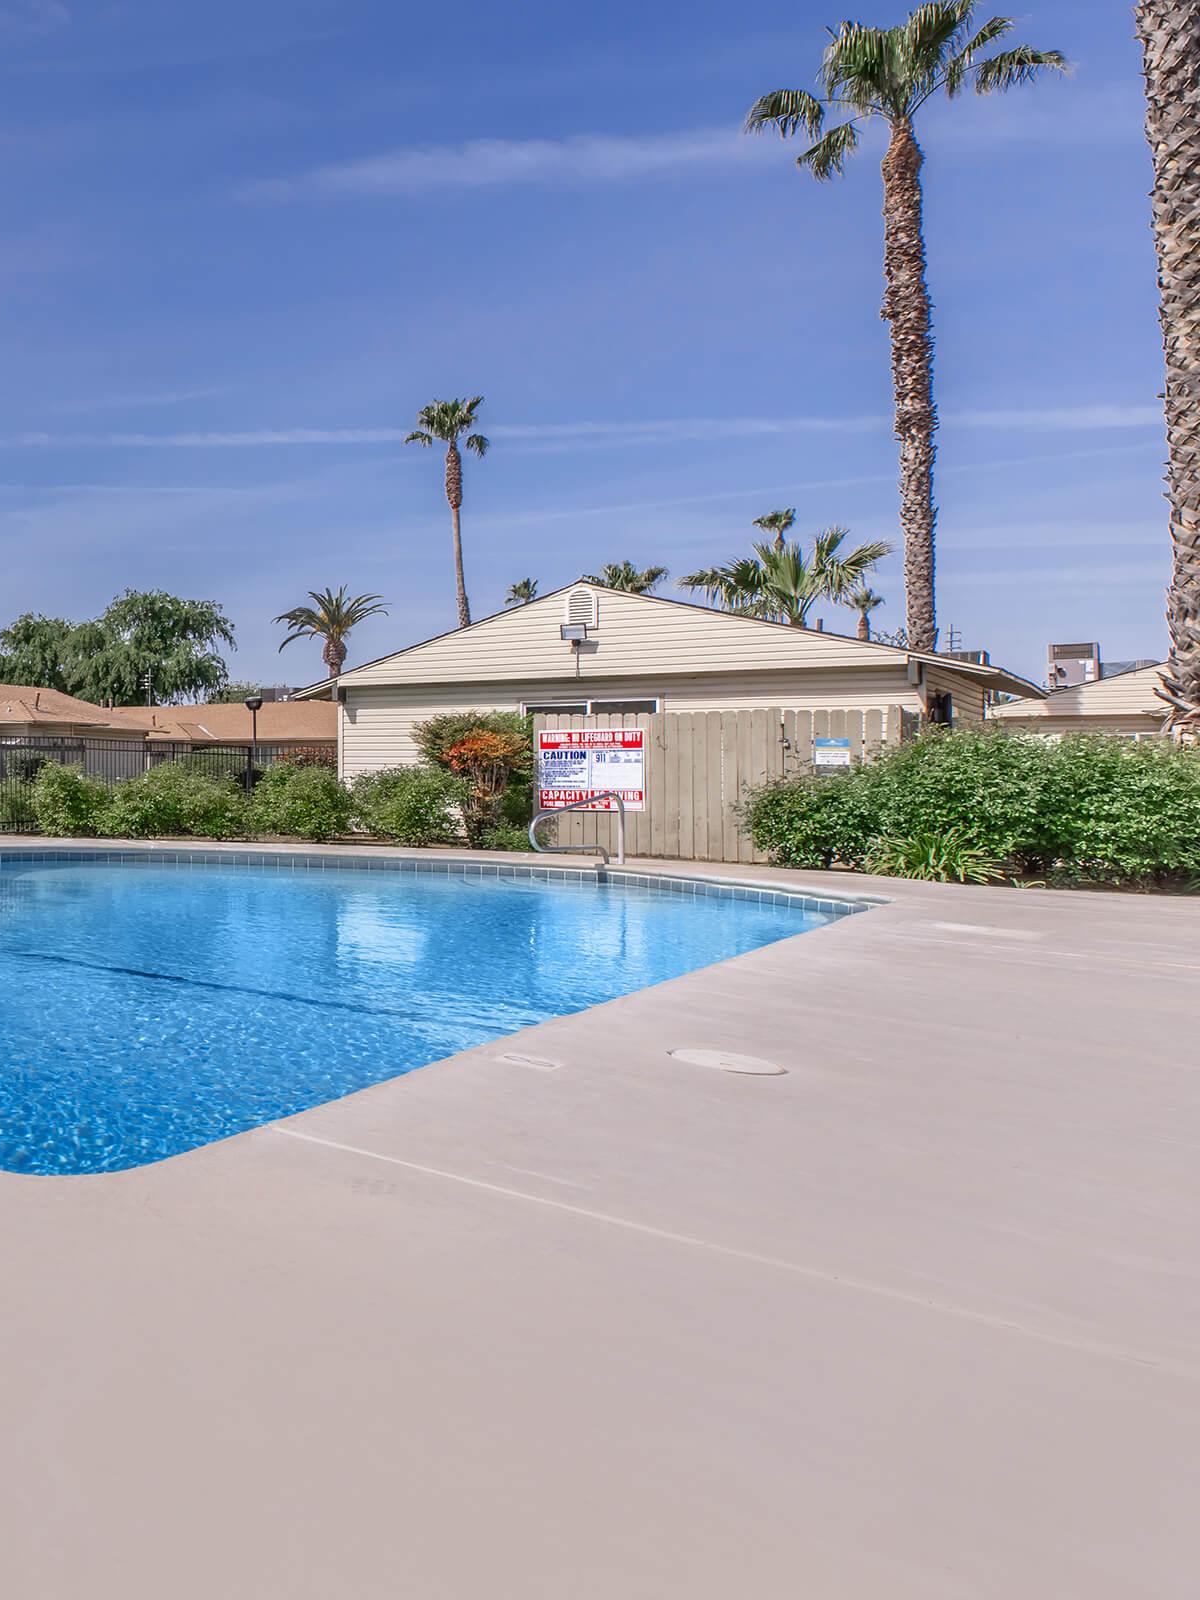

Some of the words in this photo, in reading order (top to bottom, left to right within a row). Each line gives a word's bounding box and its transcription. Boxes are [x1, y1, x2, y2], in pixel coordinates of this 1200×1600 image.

[571, 732, 580, 743] NO
[581, 732, 613, 742] LIFEGUARD
[614, 732, 623, 742] ON
[624, 731, 641, 742] DUTY
[543, 751, 586, 760] CAUTION
[595, 753, 606, 763] 911
[542, 790, 587, 800] CAPACITY
